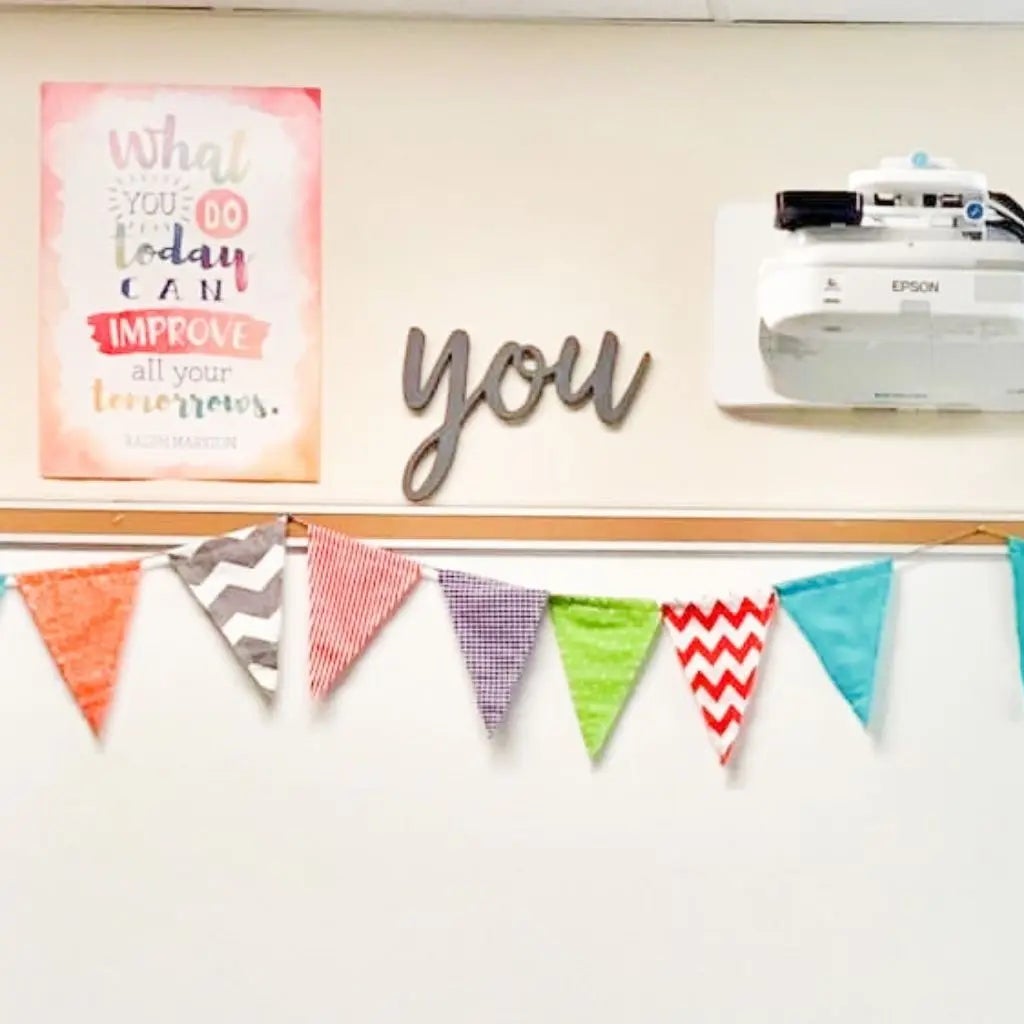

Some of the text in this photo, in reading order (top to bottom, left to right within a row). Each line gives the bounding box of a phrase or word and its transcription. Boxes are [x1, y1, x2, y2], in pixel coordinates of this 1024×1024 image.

[124, 191, 242, 230] YOU DO
[110, 219, 250, 292] today
[121, 277, 224, 303] CAN
[892, 280, 939, 292] EPSON
[109, 316, 250, 350] IMPROVE
[132, 359, 233, 388] all your
[402, 327, 653, 502] you
